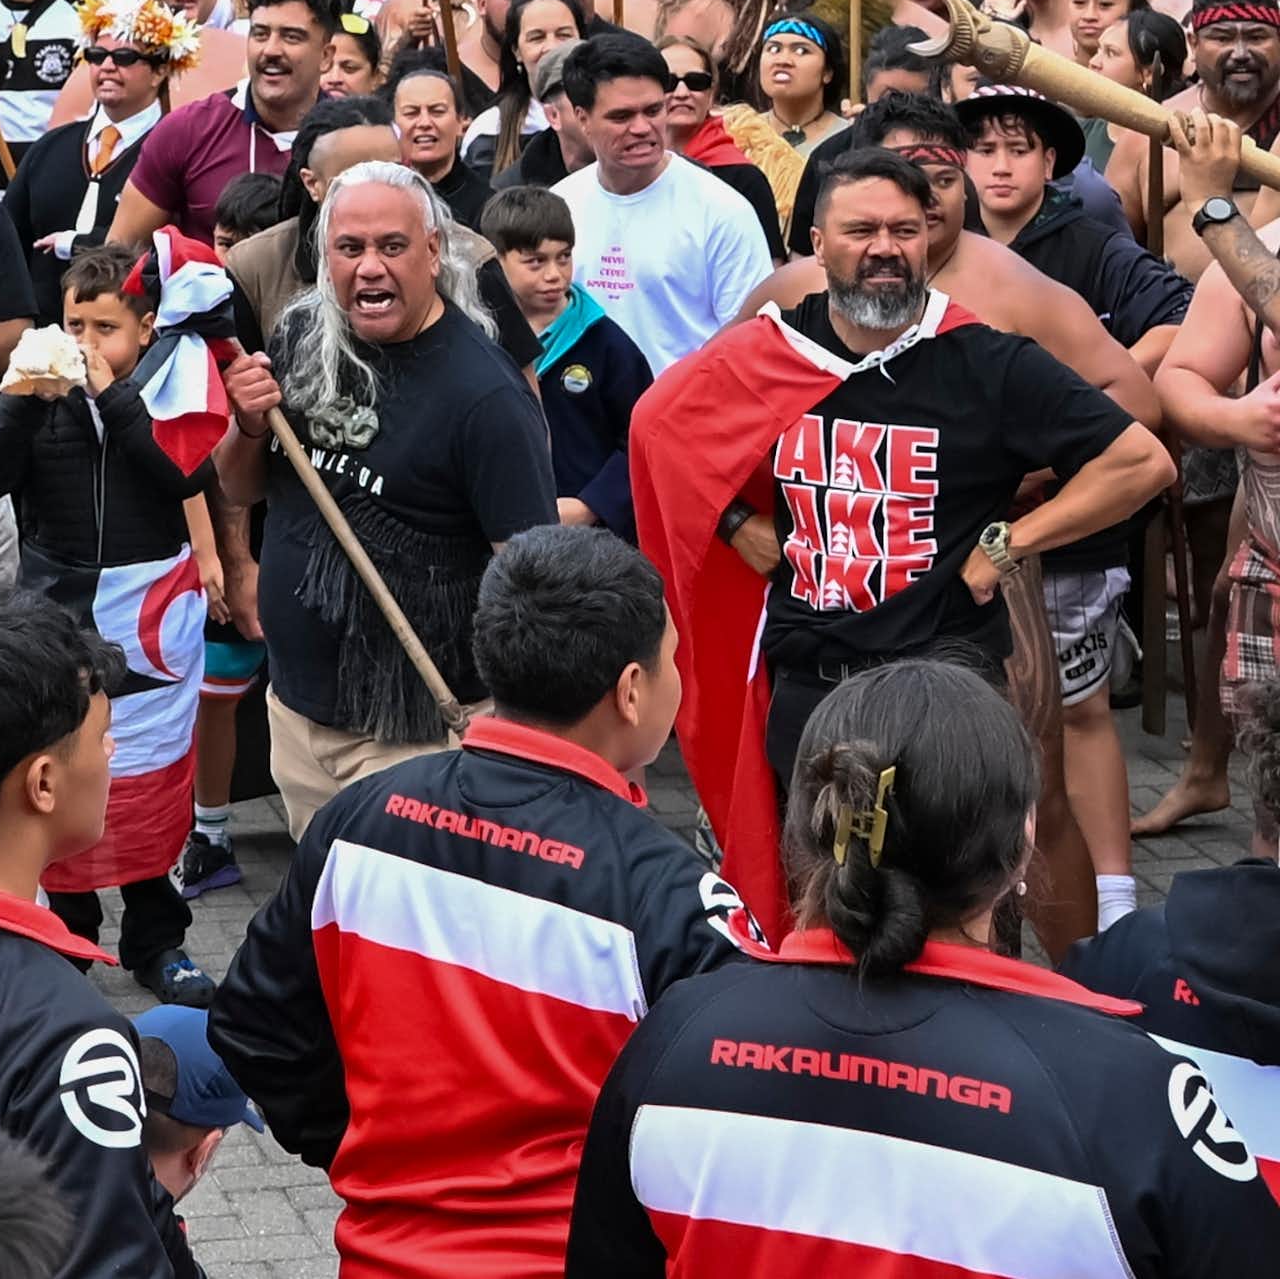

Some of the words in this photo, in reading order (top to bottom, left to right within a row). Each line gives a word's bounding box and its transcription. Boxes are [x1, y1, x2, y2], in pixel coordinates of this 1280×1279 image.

[774, 414, 939, 497] AKE
[781, 483, 938, 560] AKE
[385, 794, 585, 870] RAKAUMANGA
[711, 1039, 1013, 1114] RAKAUMANGA
